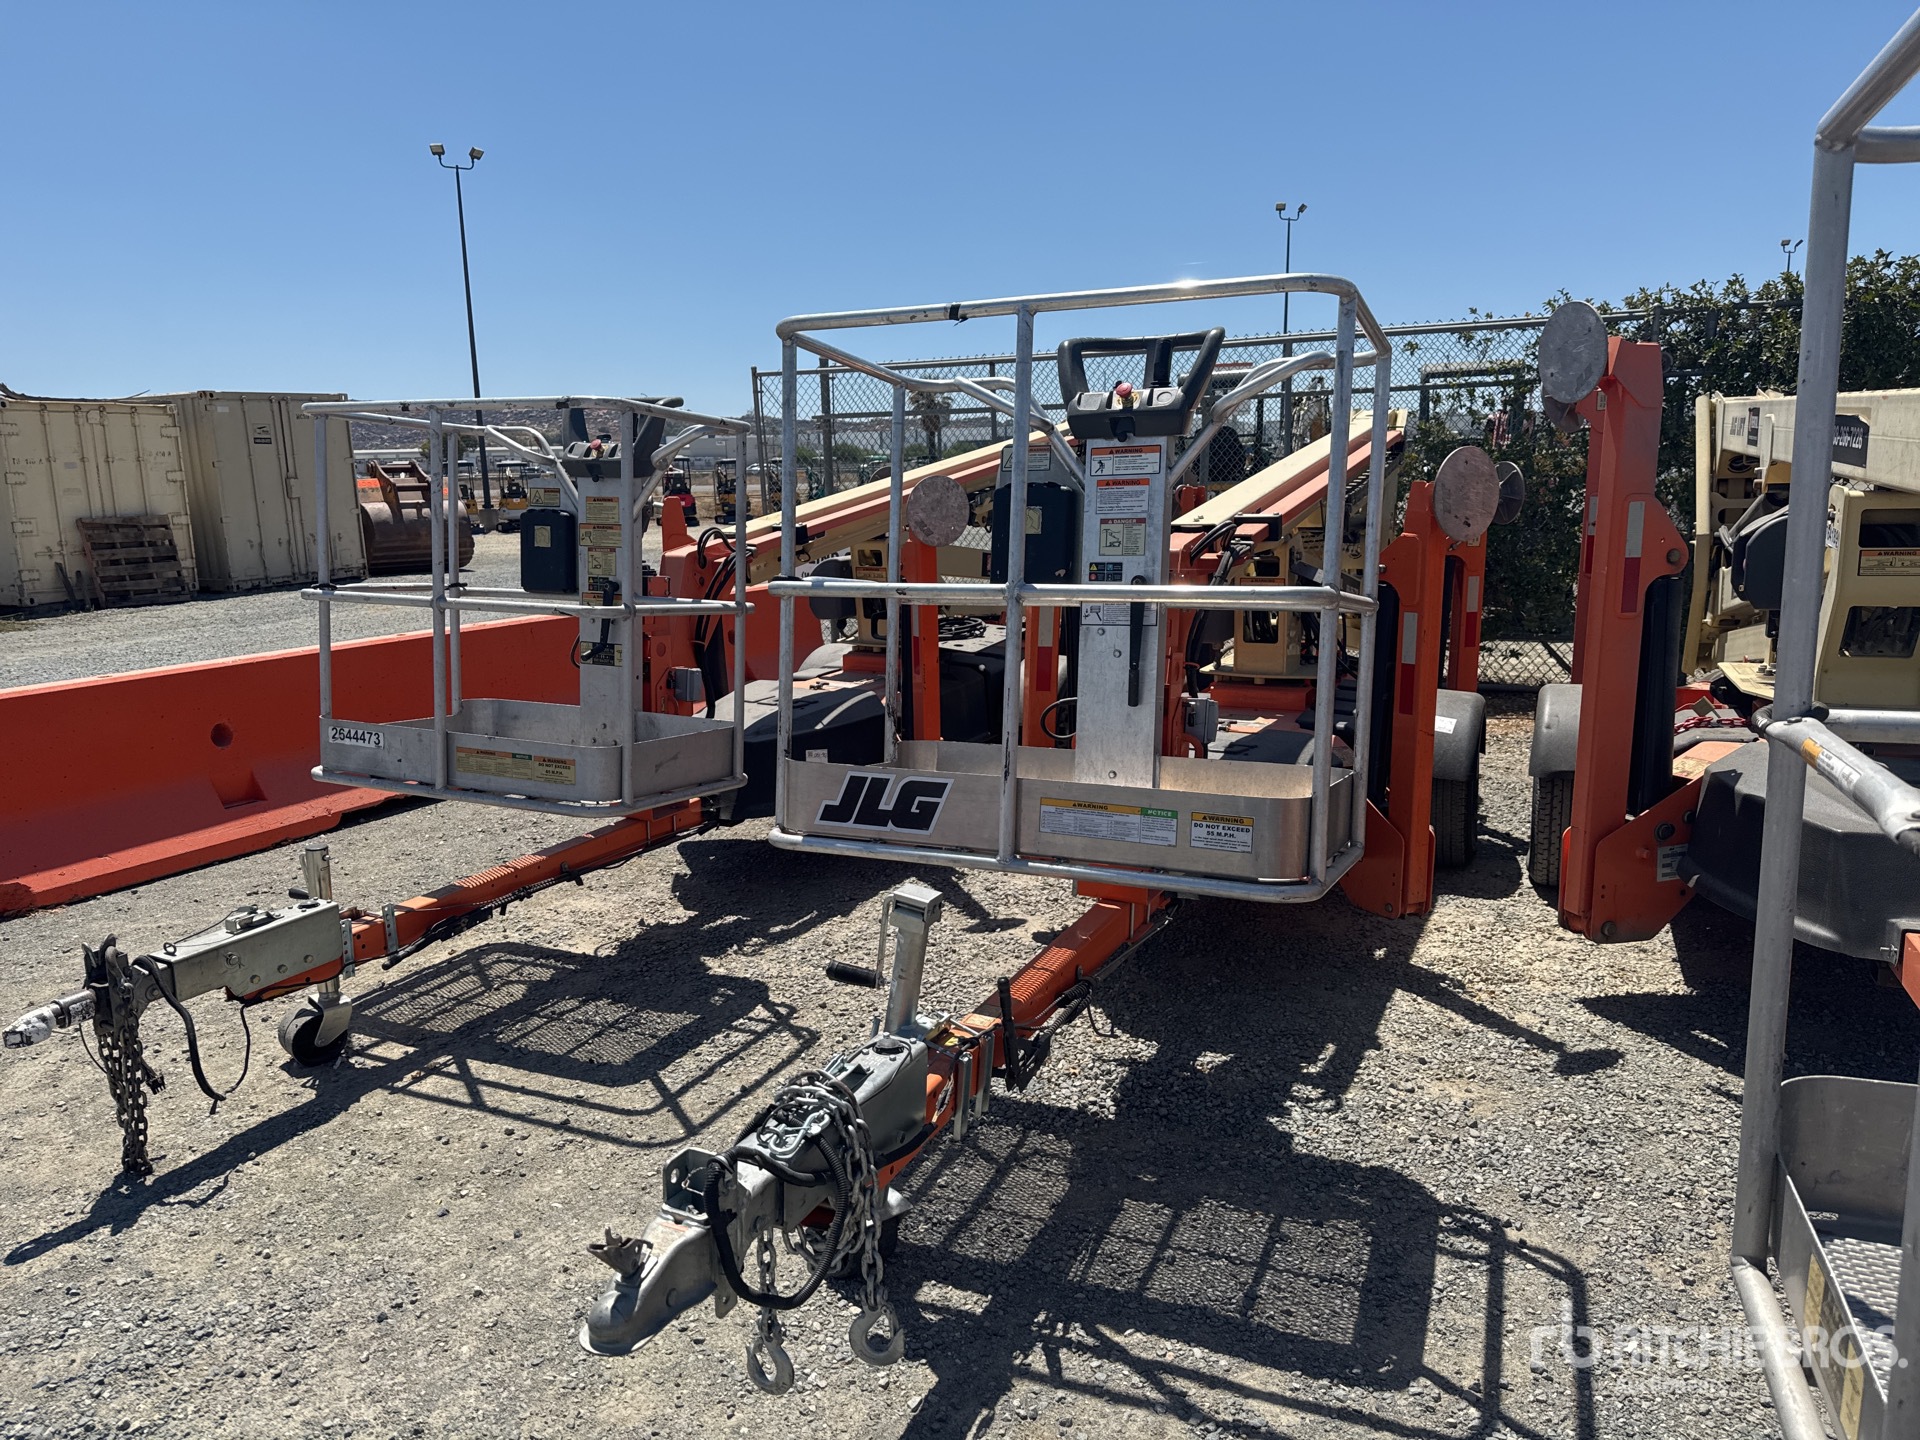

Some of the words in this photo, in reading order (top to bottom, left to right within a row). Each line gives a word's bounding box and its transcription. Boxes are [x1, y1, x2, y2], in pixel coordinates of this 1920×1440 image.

[331, 727, 381, 746] 2644473
[817, 772, 952, 832] JLG
[1147, 809, 1172, 817] NOTICE
[1208, 816, 1245, 824] WARNING
[1222, 825, 1251, 833] EXCEED
